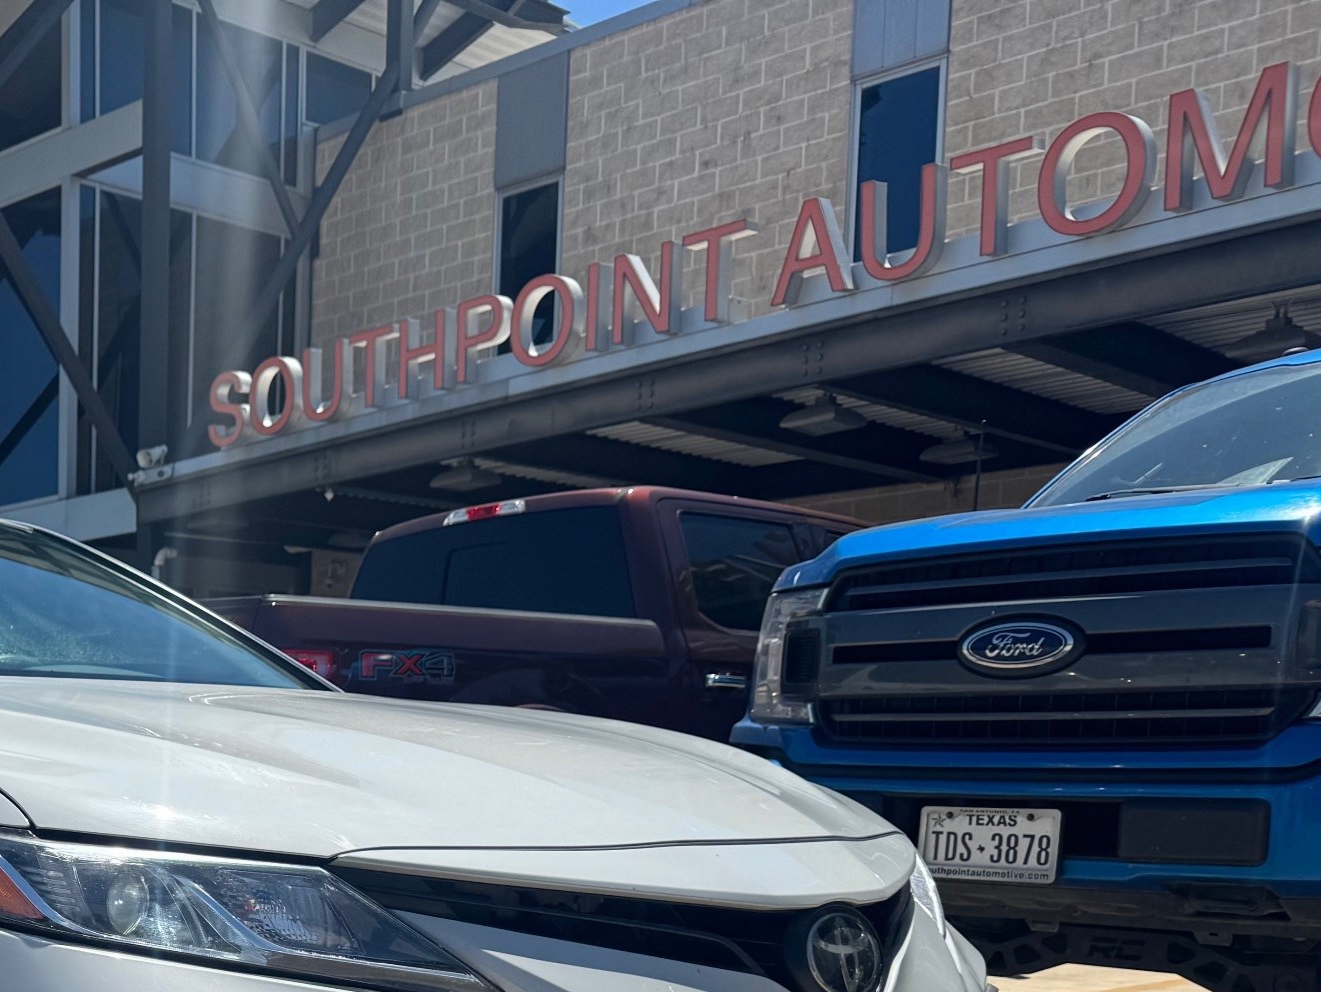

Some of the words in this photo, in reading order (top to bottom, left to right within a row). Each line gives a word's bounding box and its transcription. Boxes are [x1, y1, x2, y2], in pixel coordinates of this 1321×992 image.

[771, 61, 1321, 307] AUTOM
[985, 632, 1045, 657] Ford
[359, 649, 455, 681] FX4
[965, 814, 1018, 827] TEXAS
